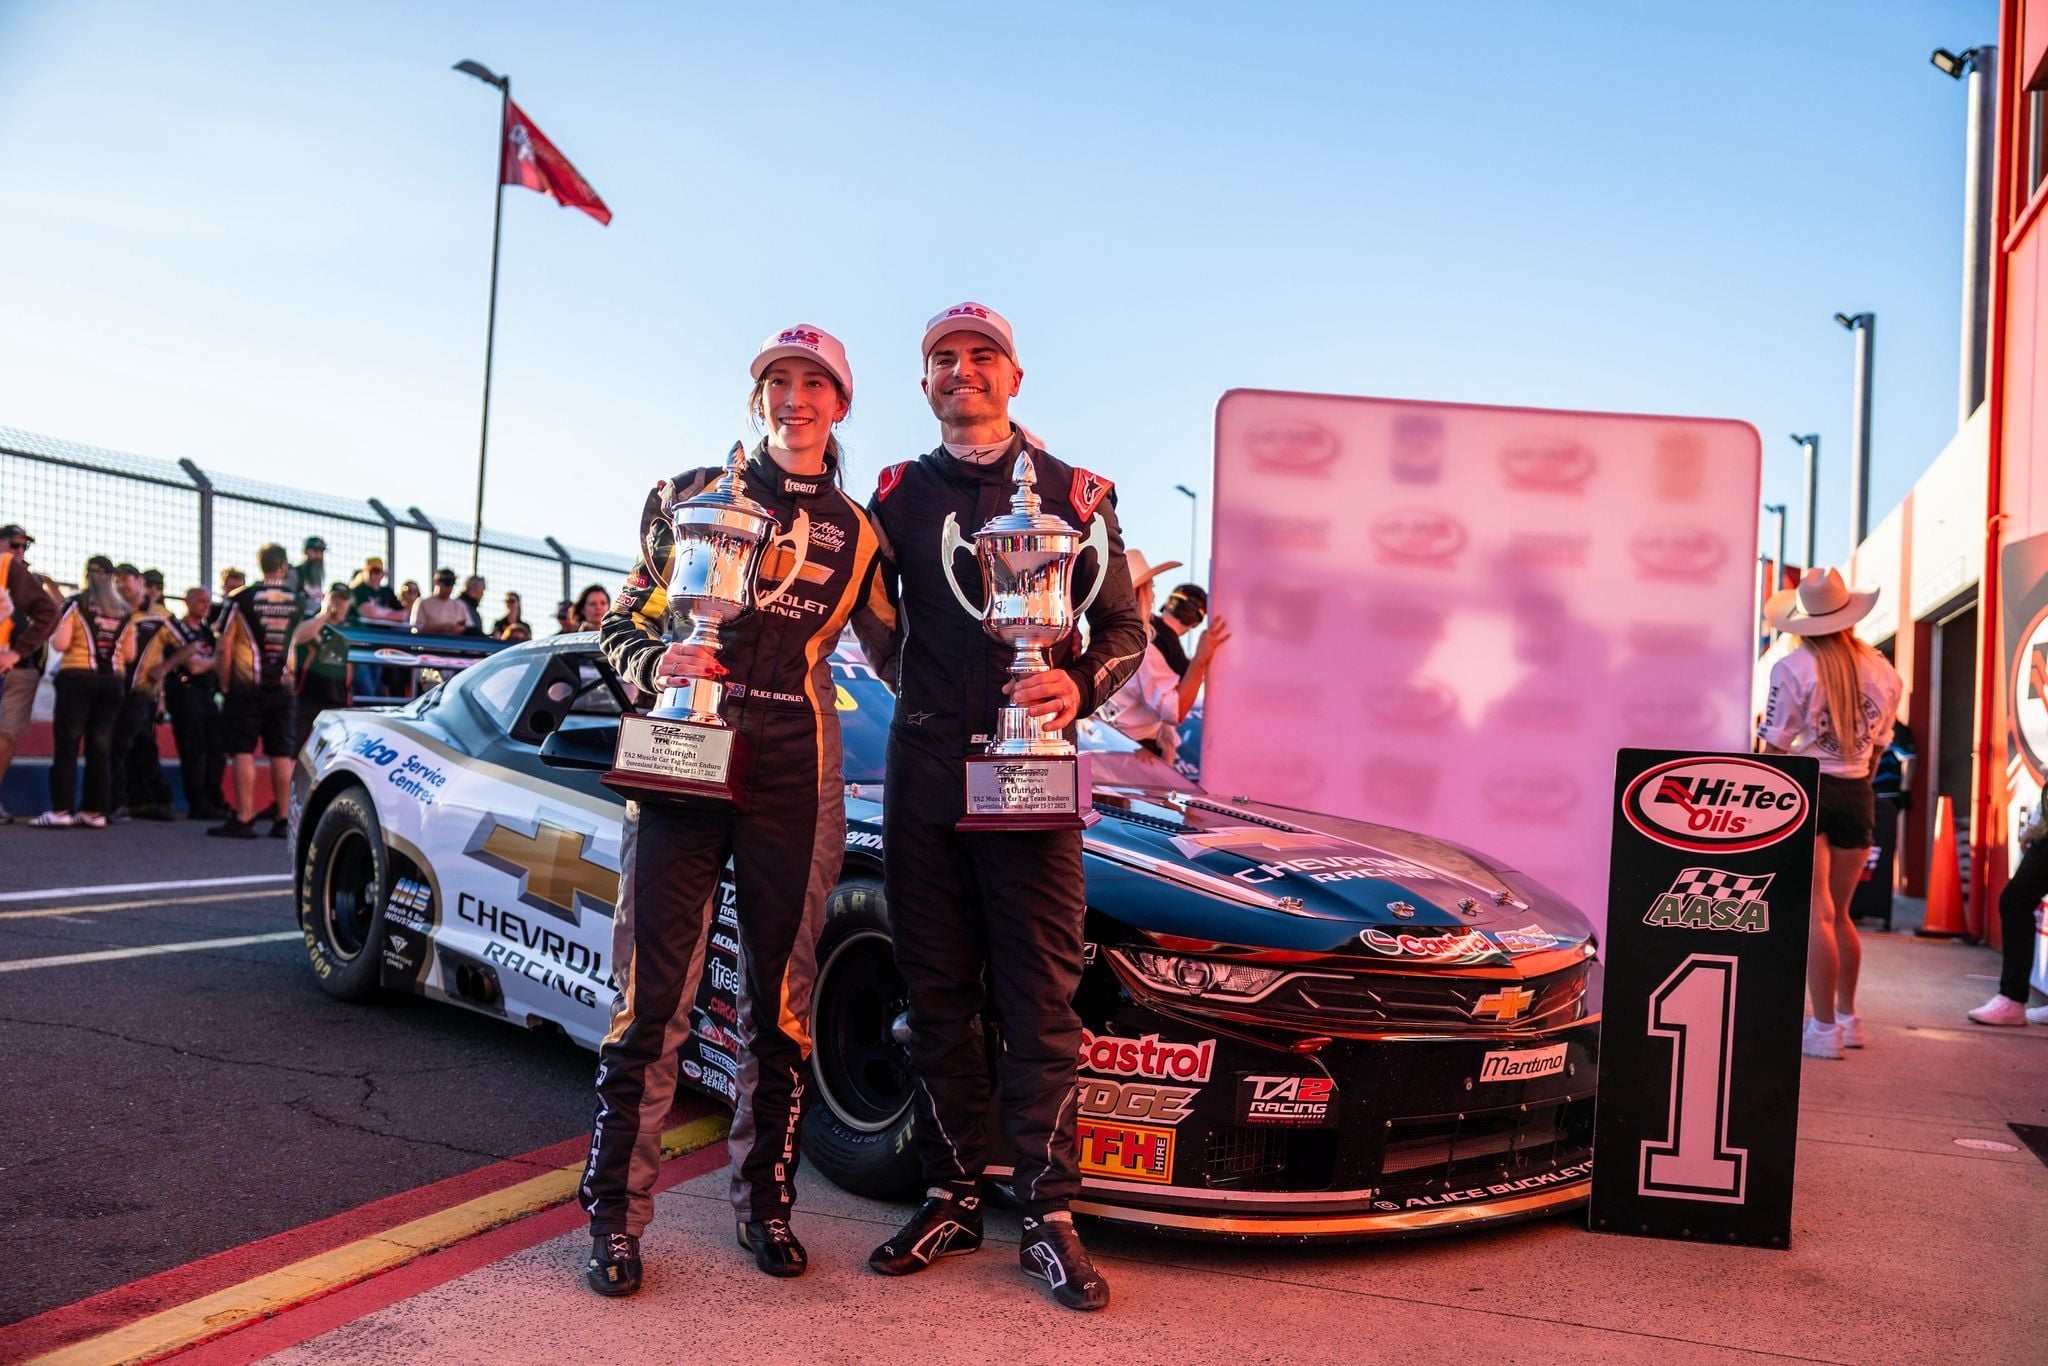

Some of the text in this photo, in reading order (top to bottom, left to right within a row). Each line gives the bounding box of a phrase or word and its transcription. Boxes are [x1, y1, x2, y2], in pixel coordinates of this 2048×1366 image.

[784, 479, 818, 494] freem
[810, 522, 845, 538] Alice
[750, 689, 804, 702] ALICE BUCKLEY
[650, 725, 681, 735] TA2
[624, 751, 636, 759] TA2
[637, 752, 658, 761] Muscle
[670, 758, 681, 766] Tag
[699, 762, 722, 770] Enduro
[652, 747, 696, 759] 1st Outright
[402, 755, 446, 787] Service
[626, 760, 653, 769] Queensland
[674, 765, 690, 774] August
[993, 765, 1023, 773] TA2
[388, 768, 435, 805] Centres
[1011, 787, 1043, 795] Outright
[1690, 778, 1797, 811] Hi-Tec
[1018, 795, 1029, 803] Tag
[1688, 808, 1747, 834] Oils
[1309, 868, 1435, 883] RACING
[1645, 893, 1769, 931] AASA
[712, 932, 739, 954] ACDel
[483, 940, 597, 1009] RACING
[711, 957, 739, 994] free
[703, 1066, 728, 1082] SUPER
[1639, 953, 1748, 1205] 1
[702, 1075, 728, 1095] SERIES
[1243, 1076, 1333, 1101] TA2
[1250, 1102, 1327, 1113] RACING
[1155, 1138, 1166, 1171] HIRE
[1406, 1188, 1488, 1208] ALICE
